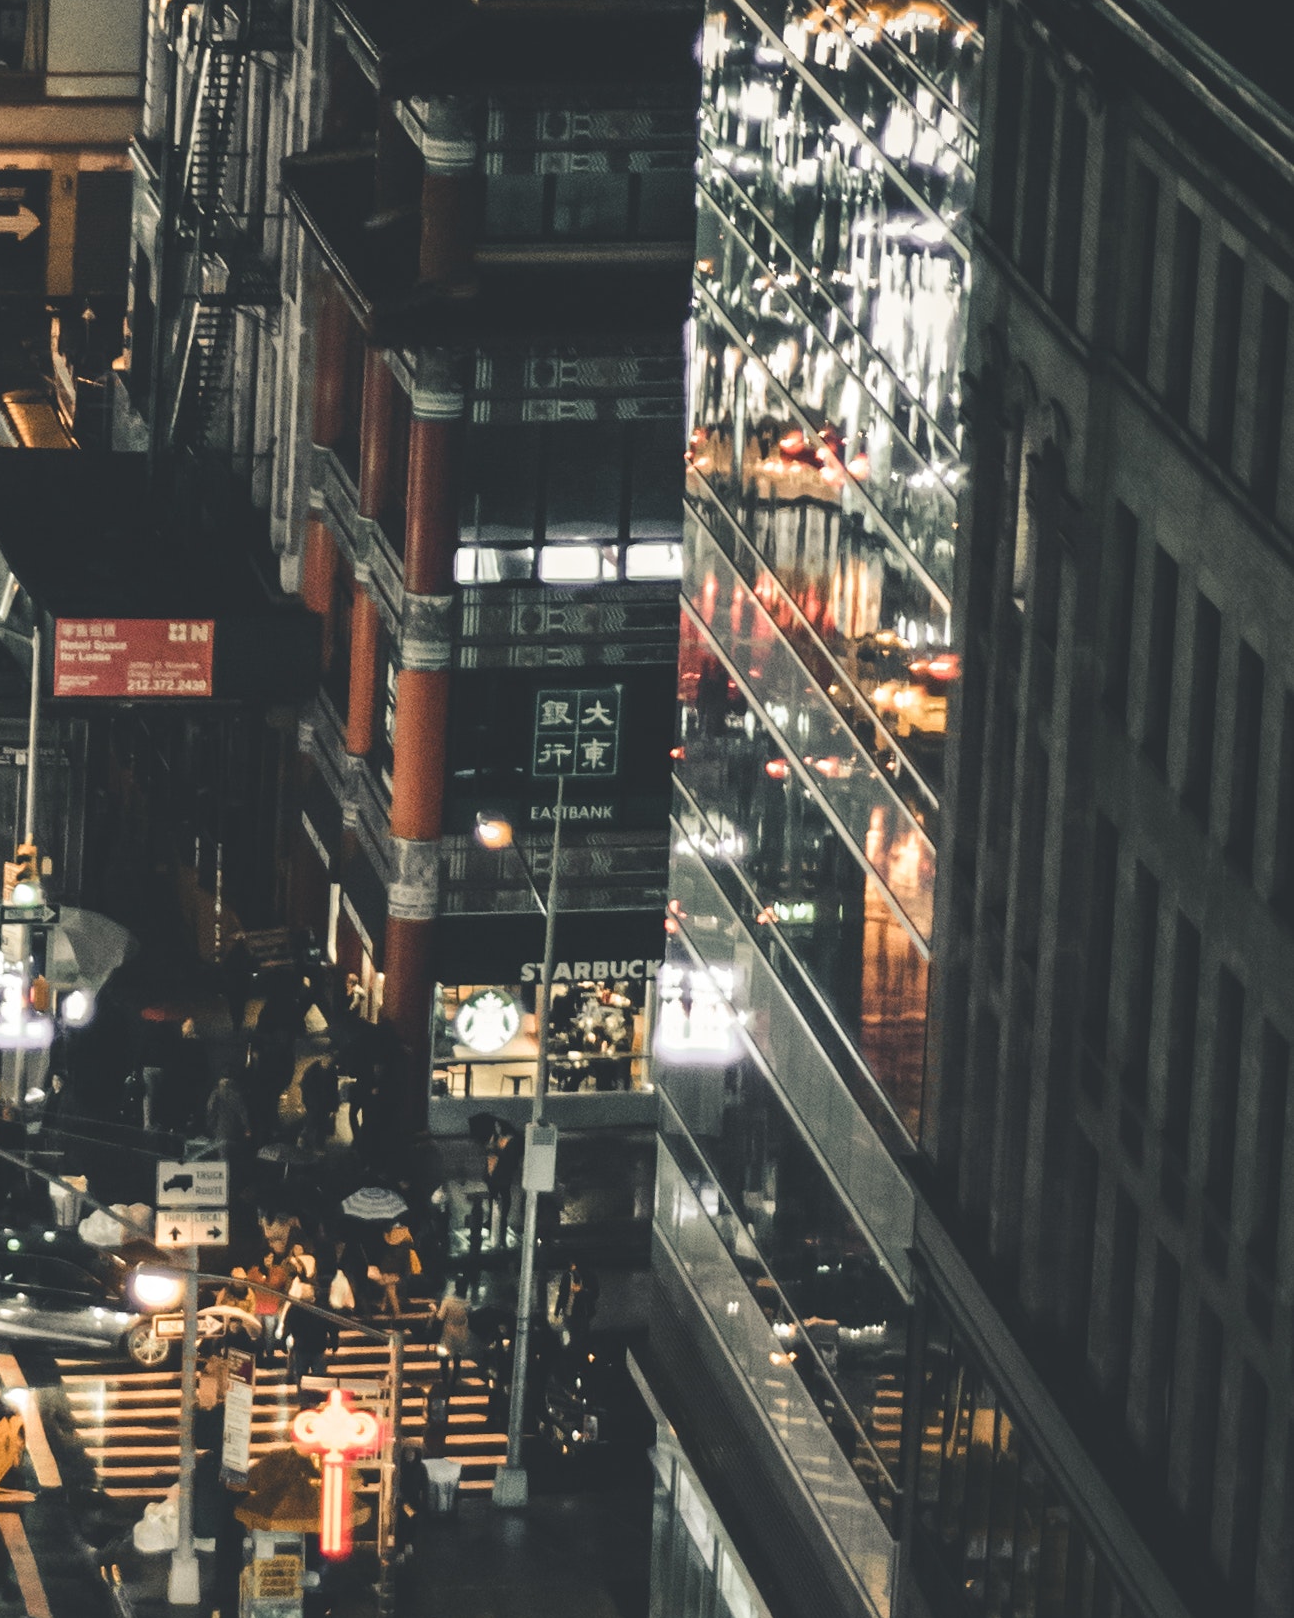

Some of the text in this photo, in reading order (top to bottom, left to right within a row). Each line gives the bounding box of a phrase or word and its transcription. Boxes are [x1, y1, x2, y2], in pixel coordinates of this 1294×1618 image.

[94, 640, 127, 651] Space
[78, 652, 111, 661] Lease
[531, 805, 613, 820] EASTBANK
[520, 959, 662, 982] STARBUCK
[195, 1170, 224, 1180] TRUCK
[195, 1185, 224, 1196] ROUTE
[164, 1213, 188, 1222] THRU
[194, 1213, 223, 1222] LOCAL
